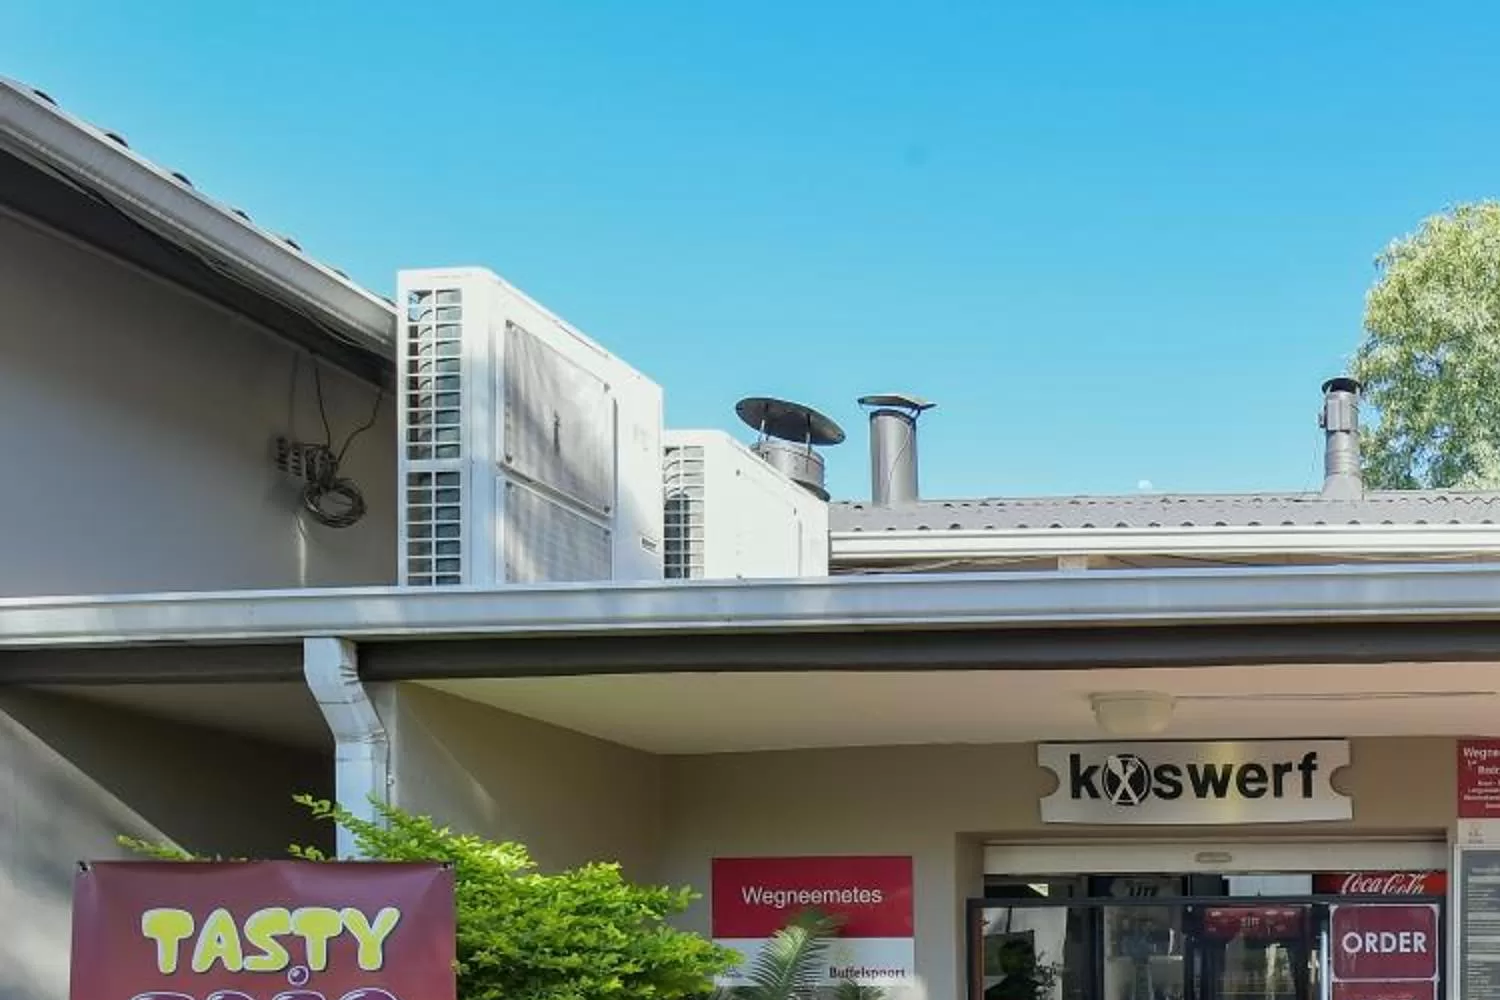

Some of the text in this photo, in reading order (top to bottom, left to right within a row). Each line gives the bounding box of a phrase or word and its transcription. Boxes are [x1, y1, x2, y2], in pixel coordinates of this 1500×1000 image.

[742, 886, 882, 909] Wegneemetes
[142, 908, 400, 973] TASTY
[1341, 932, 1426, 953] ORDER
[829, 966, 905, 979] Buffelspoort
